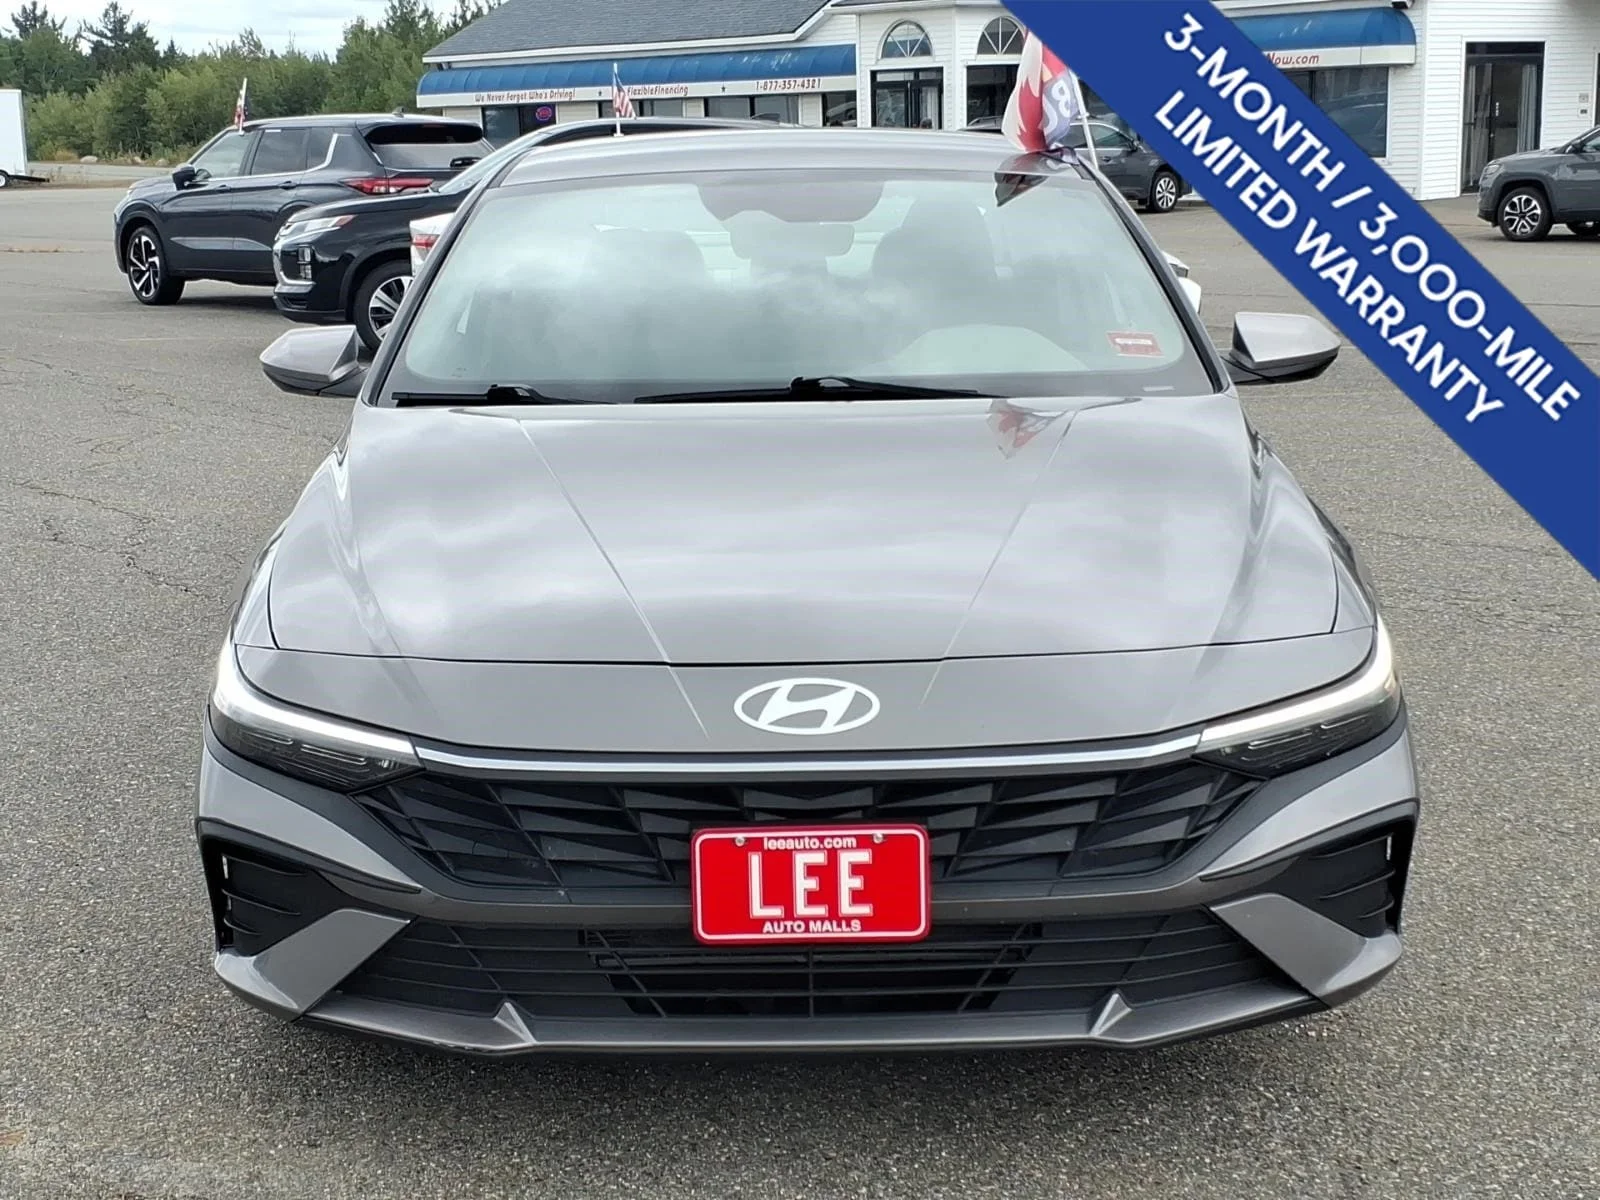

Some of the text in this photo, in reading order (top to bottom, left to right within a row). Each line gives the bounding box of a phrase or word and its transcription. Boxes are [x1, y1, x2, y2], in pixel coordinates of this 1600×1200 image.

[756, 78, 821, 91] 1-877-357-4321
[475, 89, 576, 103] We Never Forget Who's Driving!
[763, 836, 857, 850] leeauto.com
[748, 848, 873, 918] LEE
[763, 919, 862, 934] AUTO MALLS
